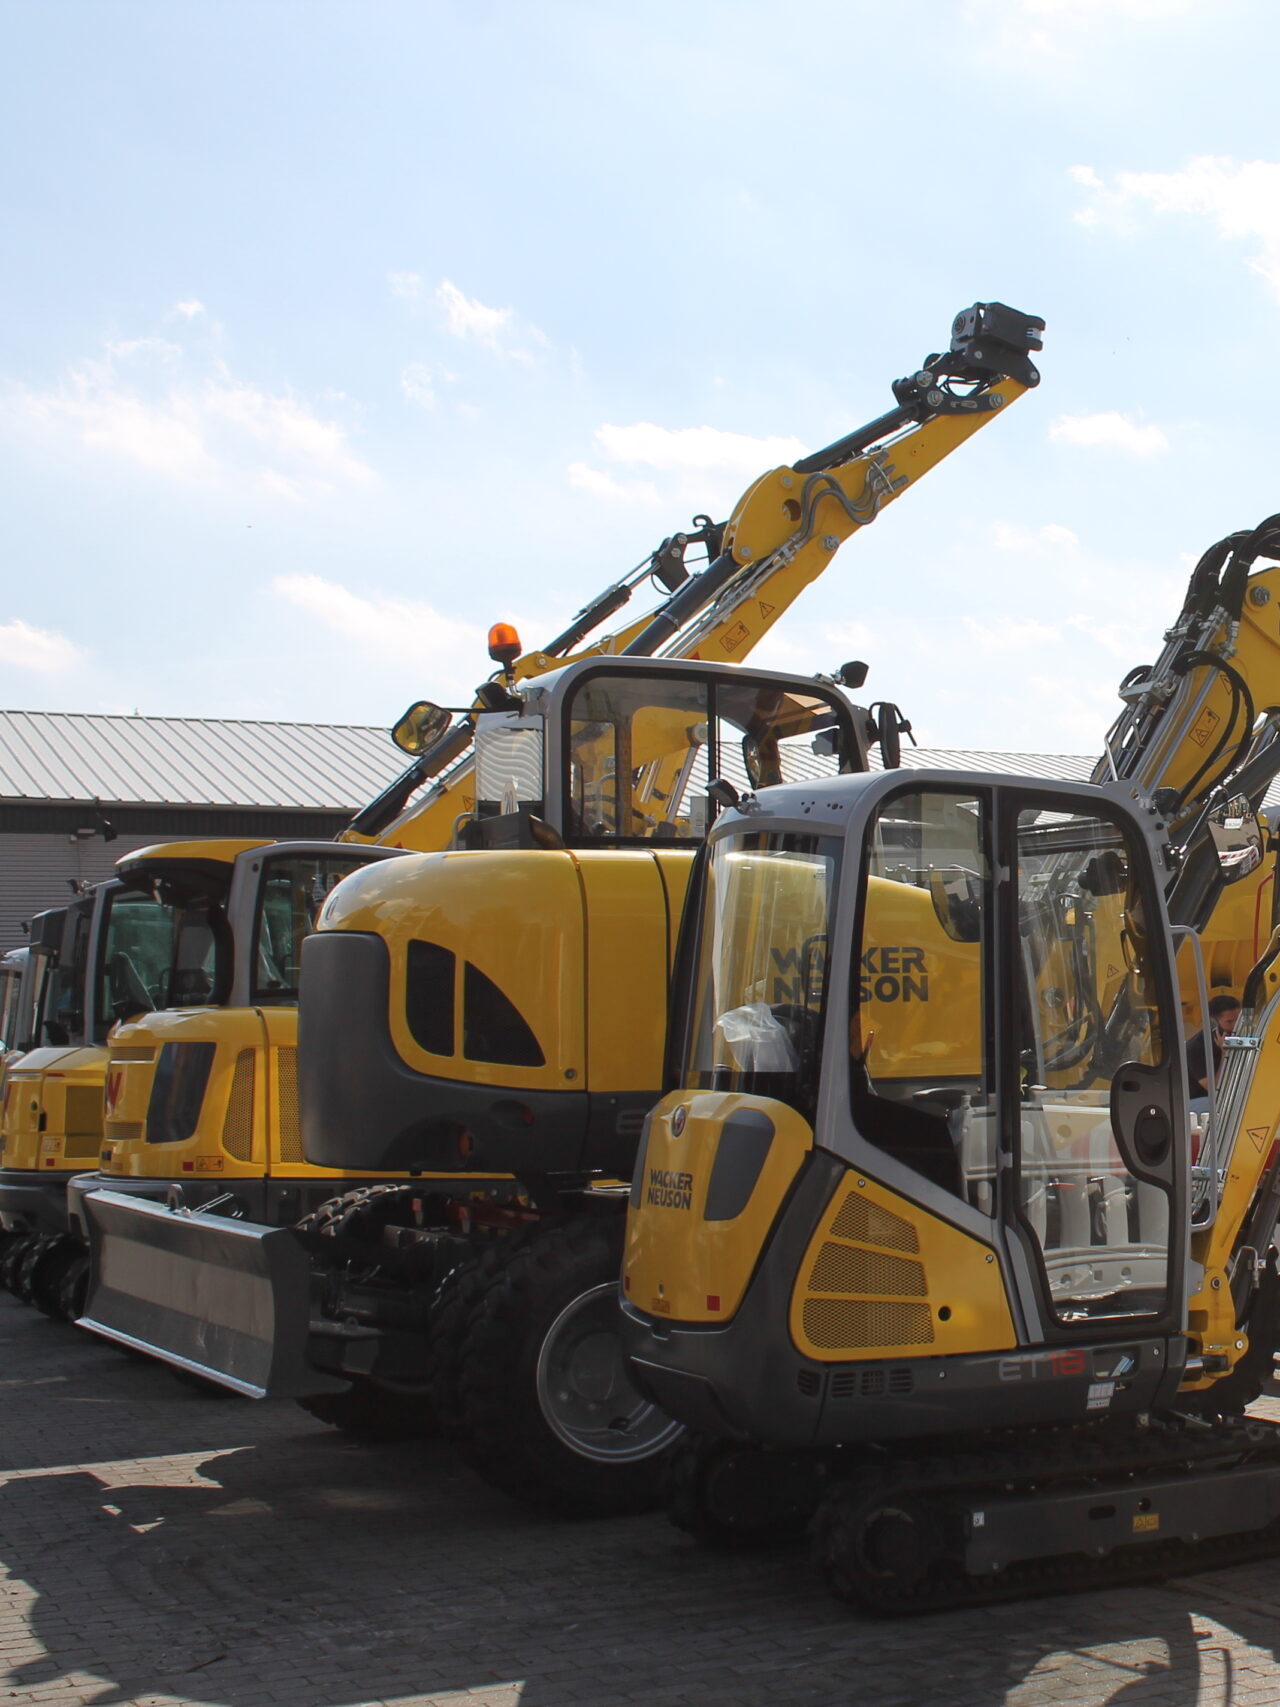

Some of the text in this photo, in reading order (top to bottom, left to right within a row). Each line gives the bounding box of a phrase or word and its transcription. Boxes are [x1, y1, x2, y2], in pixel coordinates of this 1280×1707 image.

[771, 946, 928, 974] WAKER
[773, 975, 928, 1003] NESON
[650, 1169, 693, 1191] WACKER
[647, 1187, 692, 1211] NEUSON
